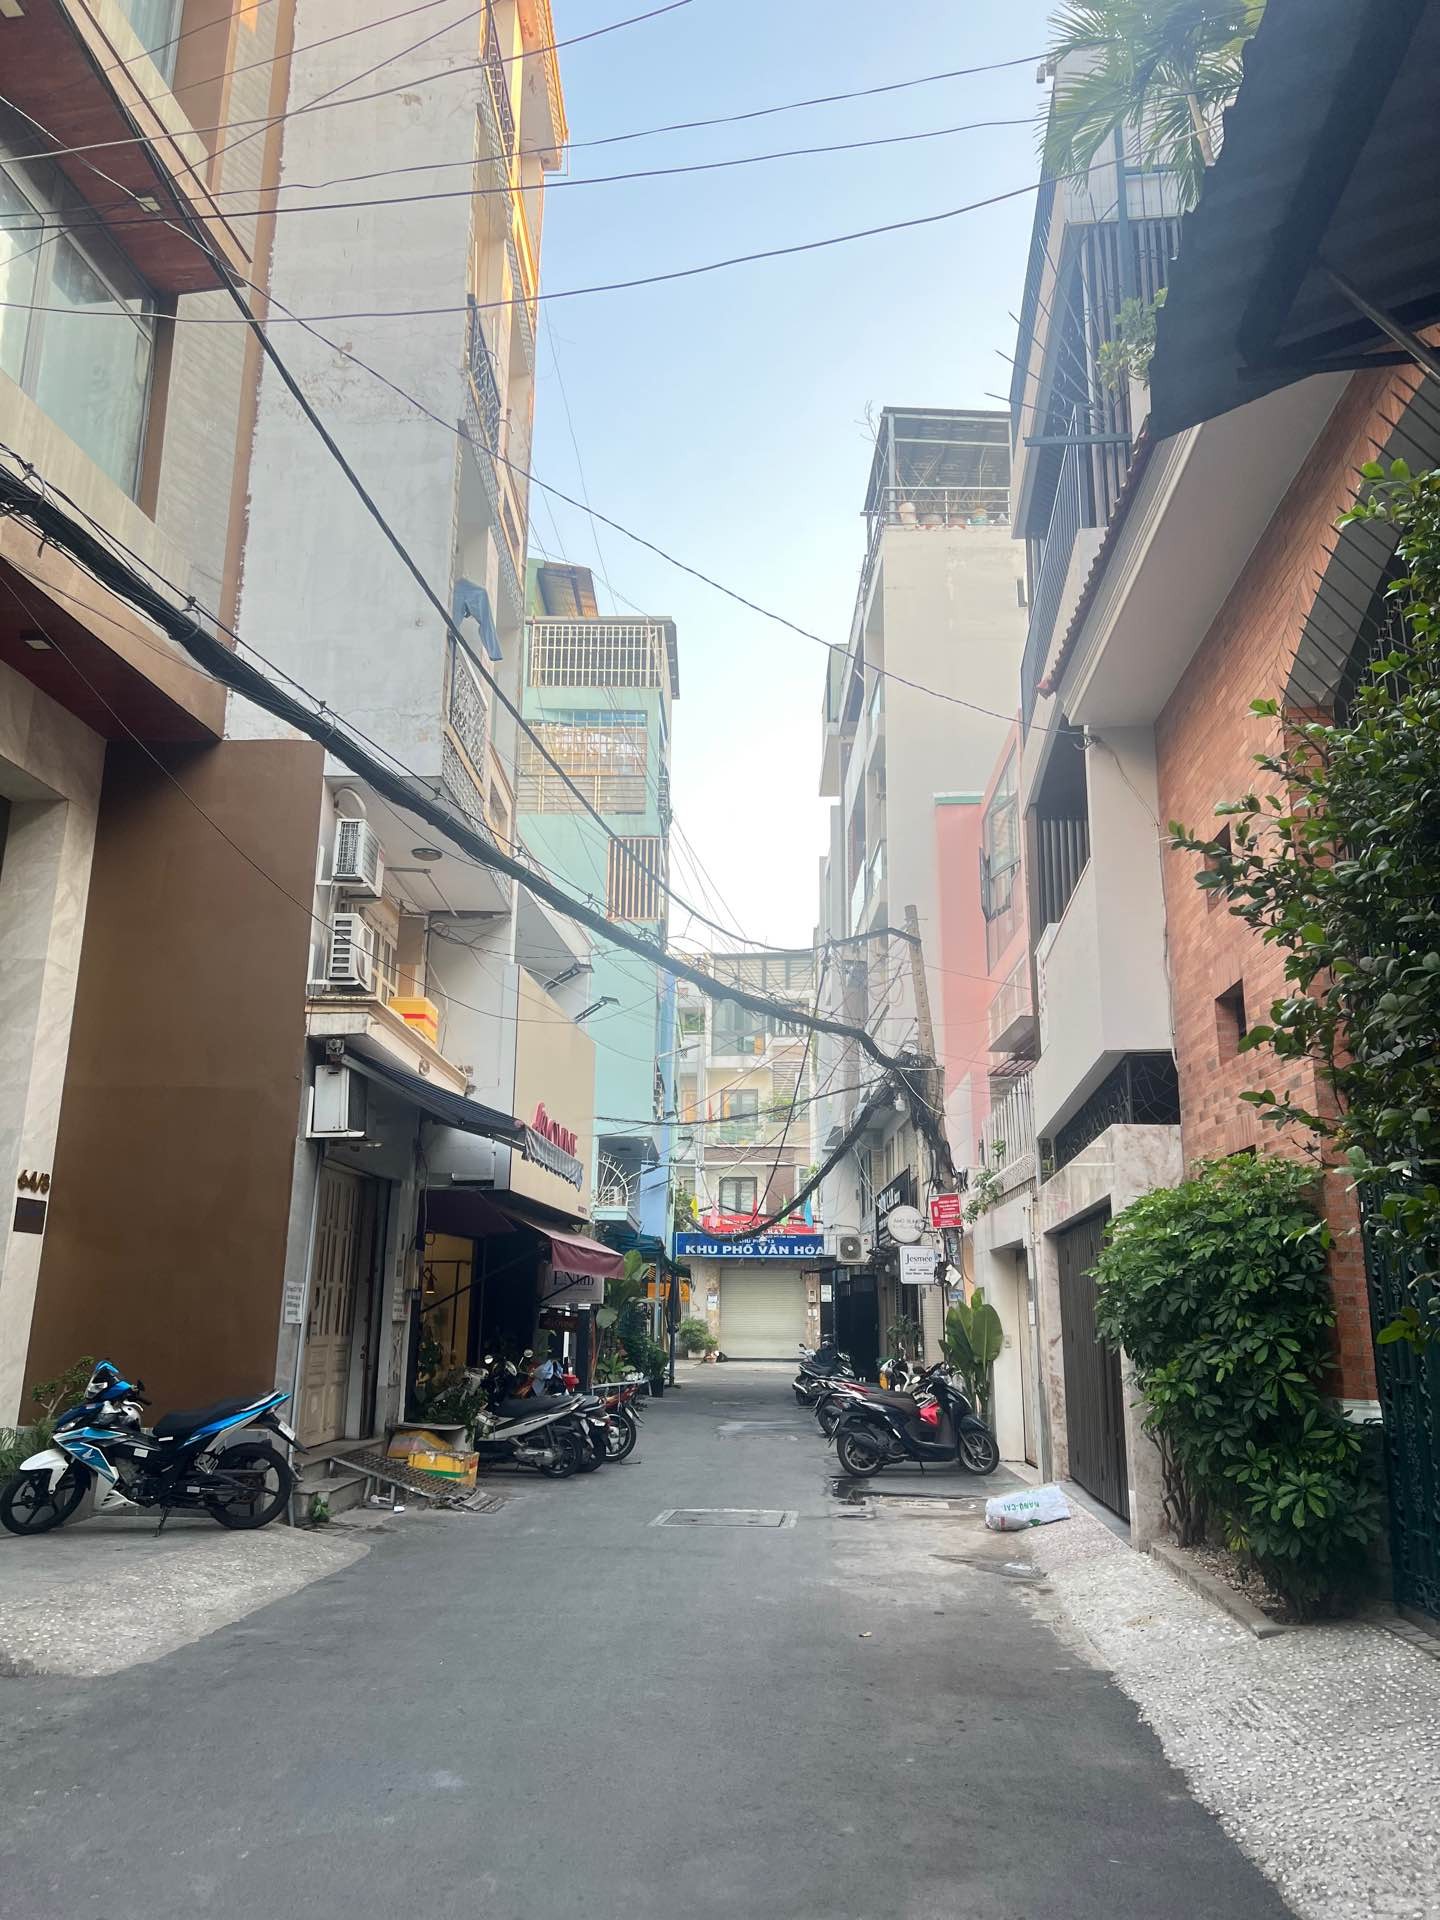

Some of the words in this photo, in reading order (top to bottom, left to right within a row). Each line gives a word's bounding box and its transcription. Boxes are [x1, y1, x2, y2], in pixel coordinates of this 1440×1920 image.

[685, 1245, 718, 1254] KHU
[722, 1242, 754, 1254] PHỐ
[758, 1243, 789, 1254] VĂN
[793, 1243, 824, 1254] HÓA
